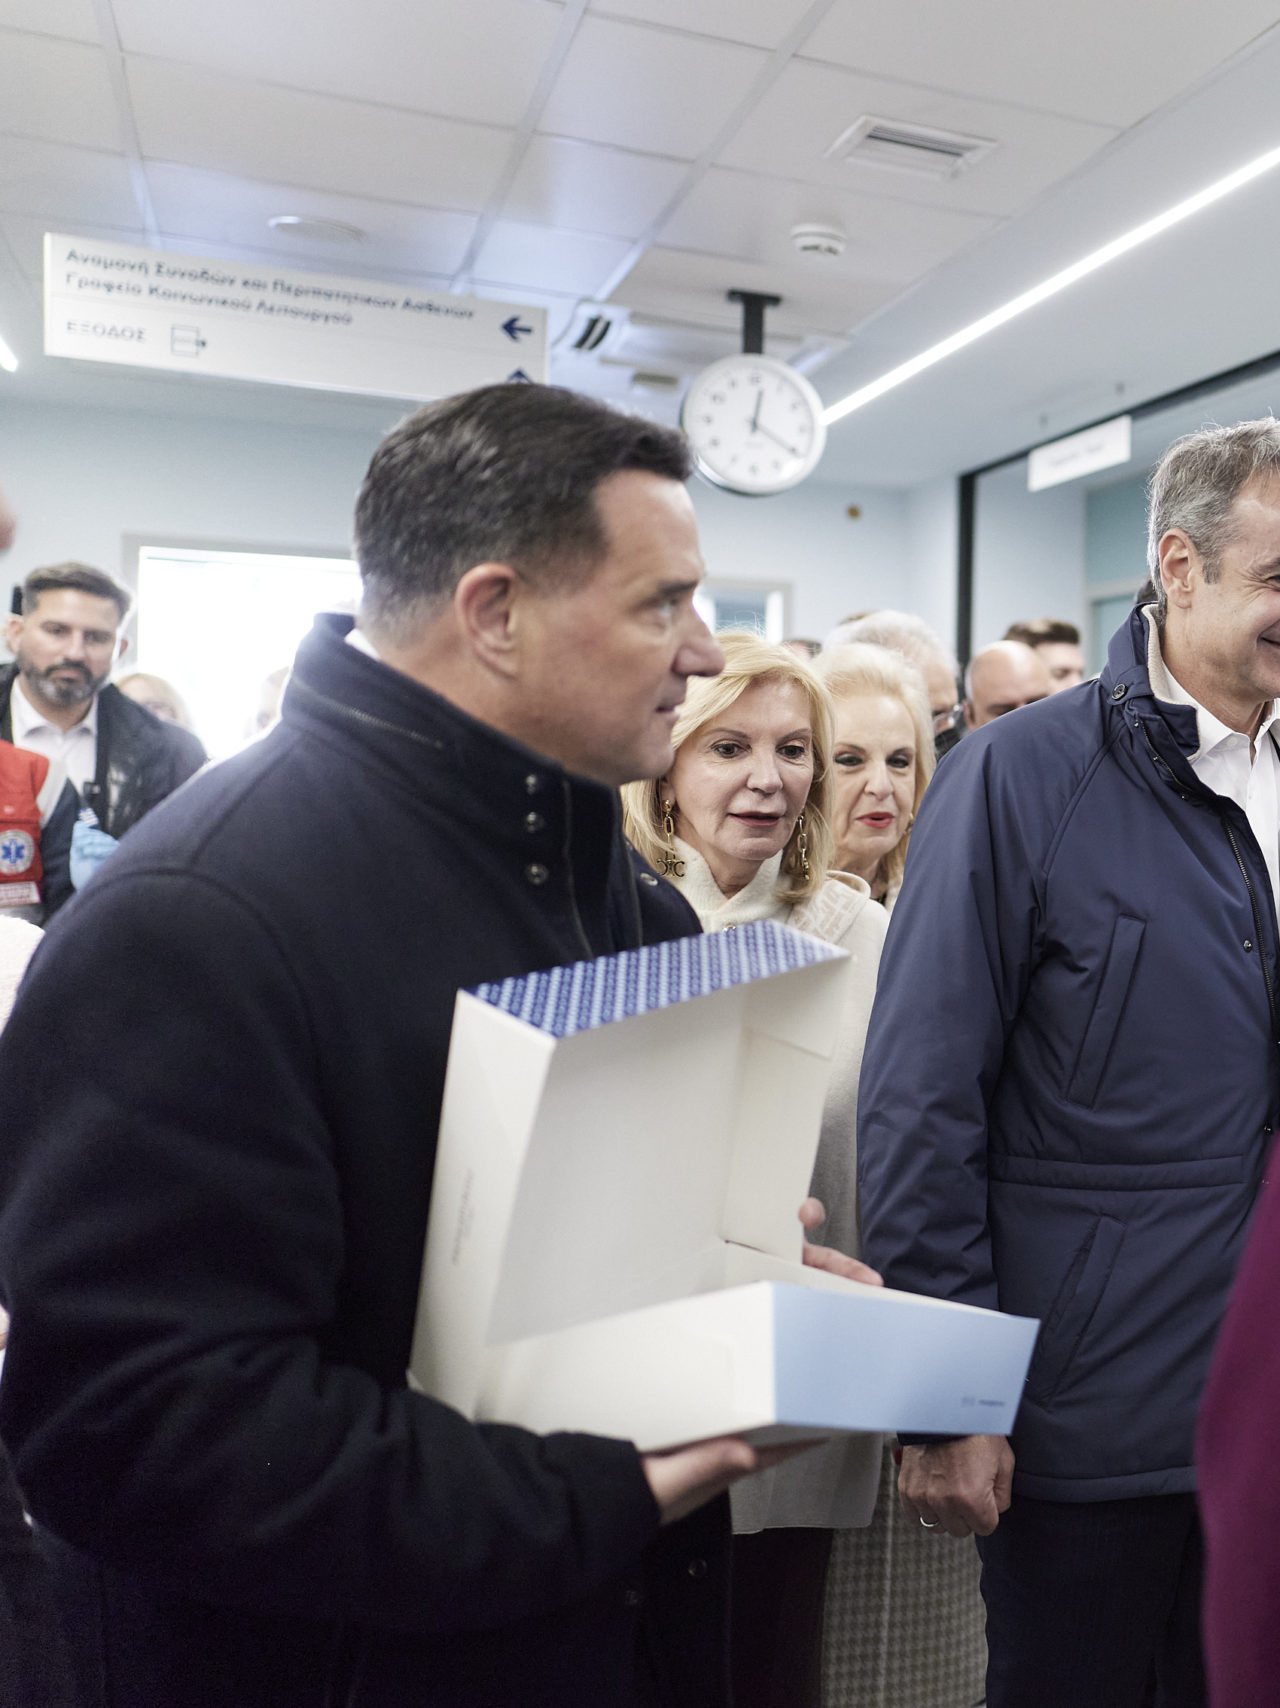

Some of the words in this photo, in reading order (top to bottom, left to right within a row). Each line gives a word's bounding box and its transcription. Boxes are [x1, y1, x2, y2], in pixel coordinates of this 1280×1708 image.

[66, 248, 149, 276] Αναμονή
[66, 271, 143, 296] Γραφείο
[66, 320, 147, 343] ΕΞΟΔΟΣ
